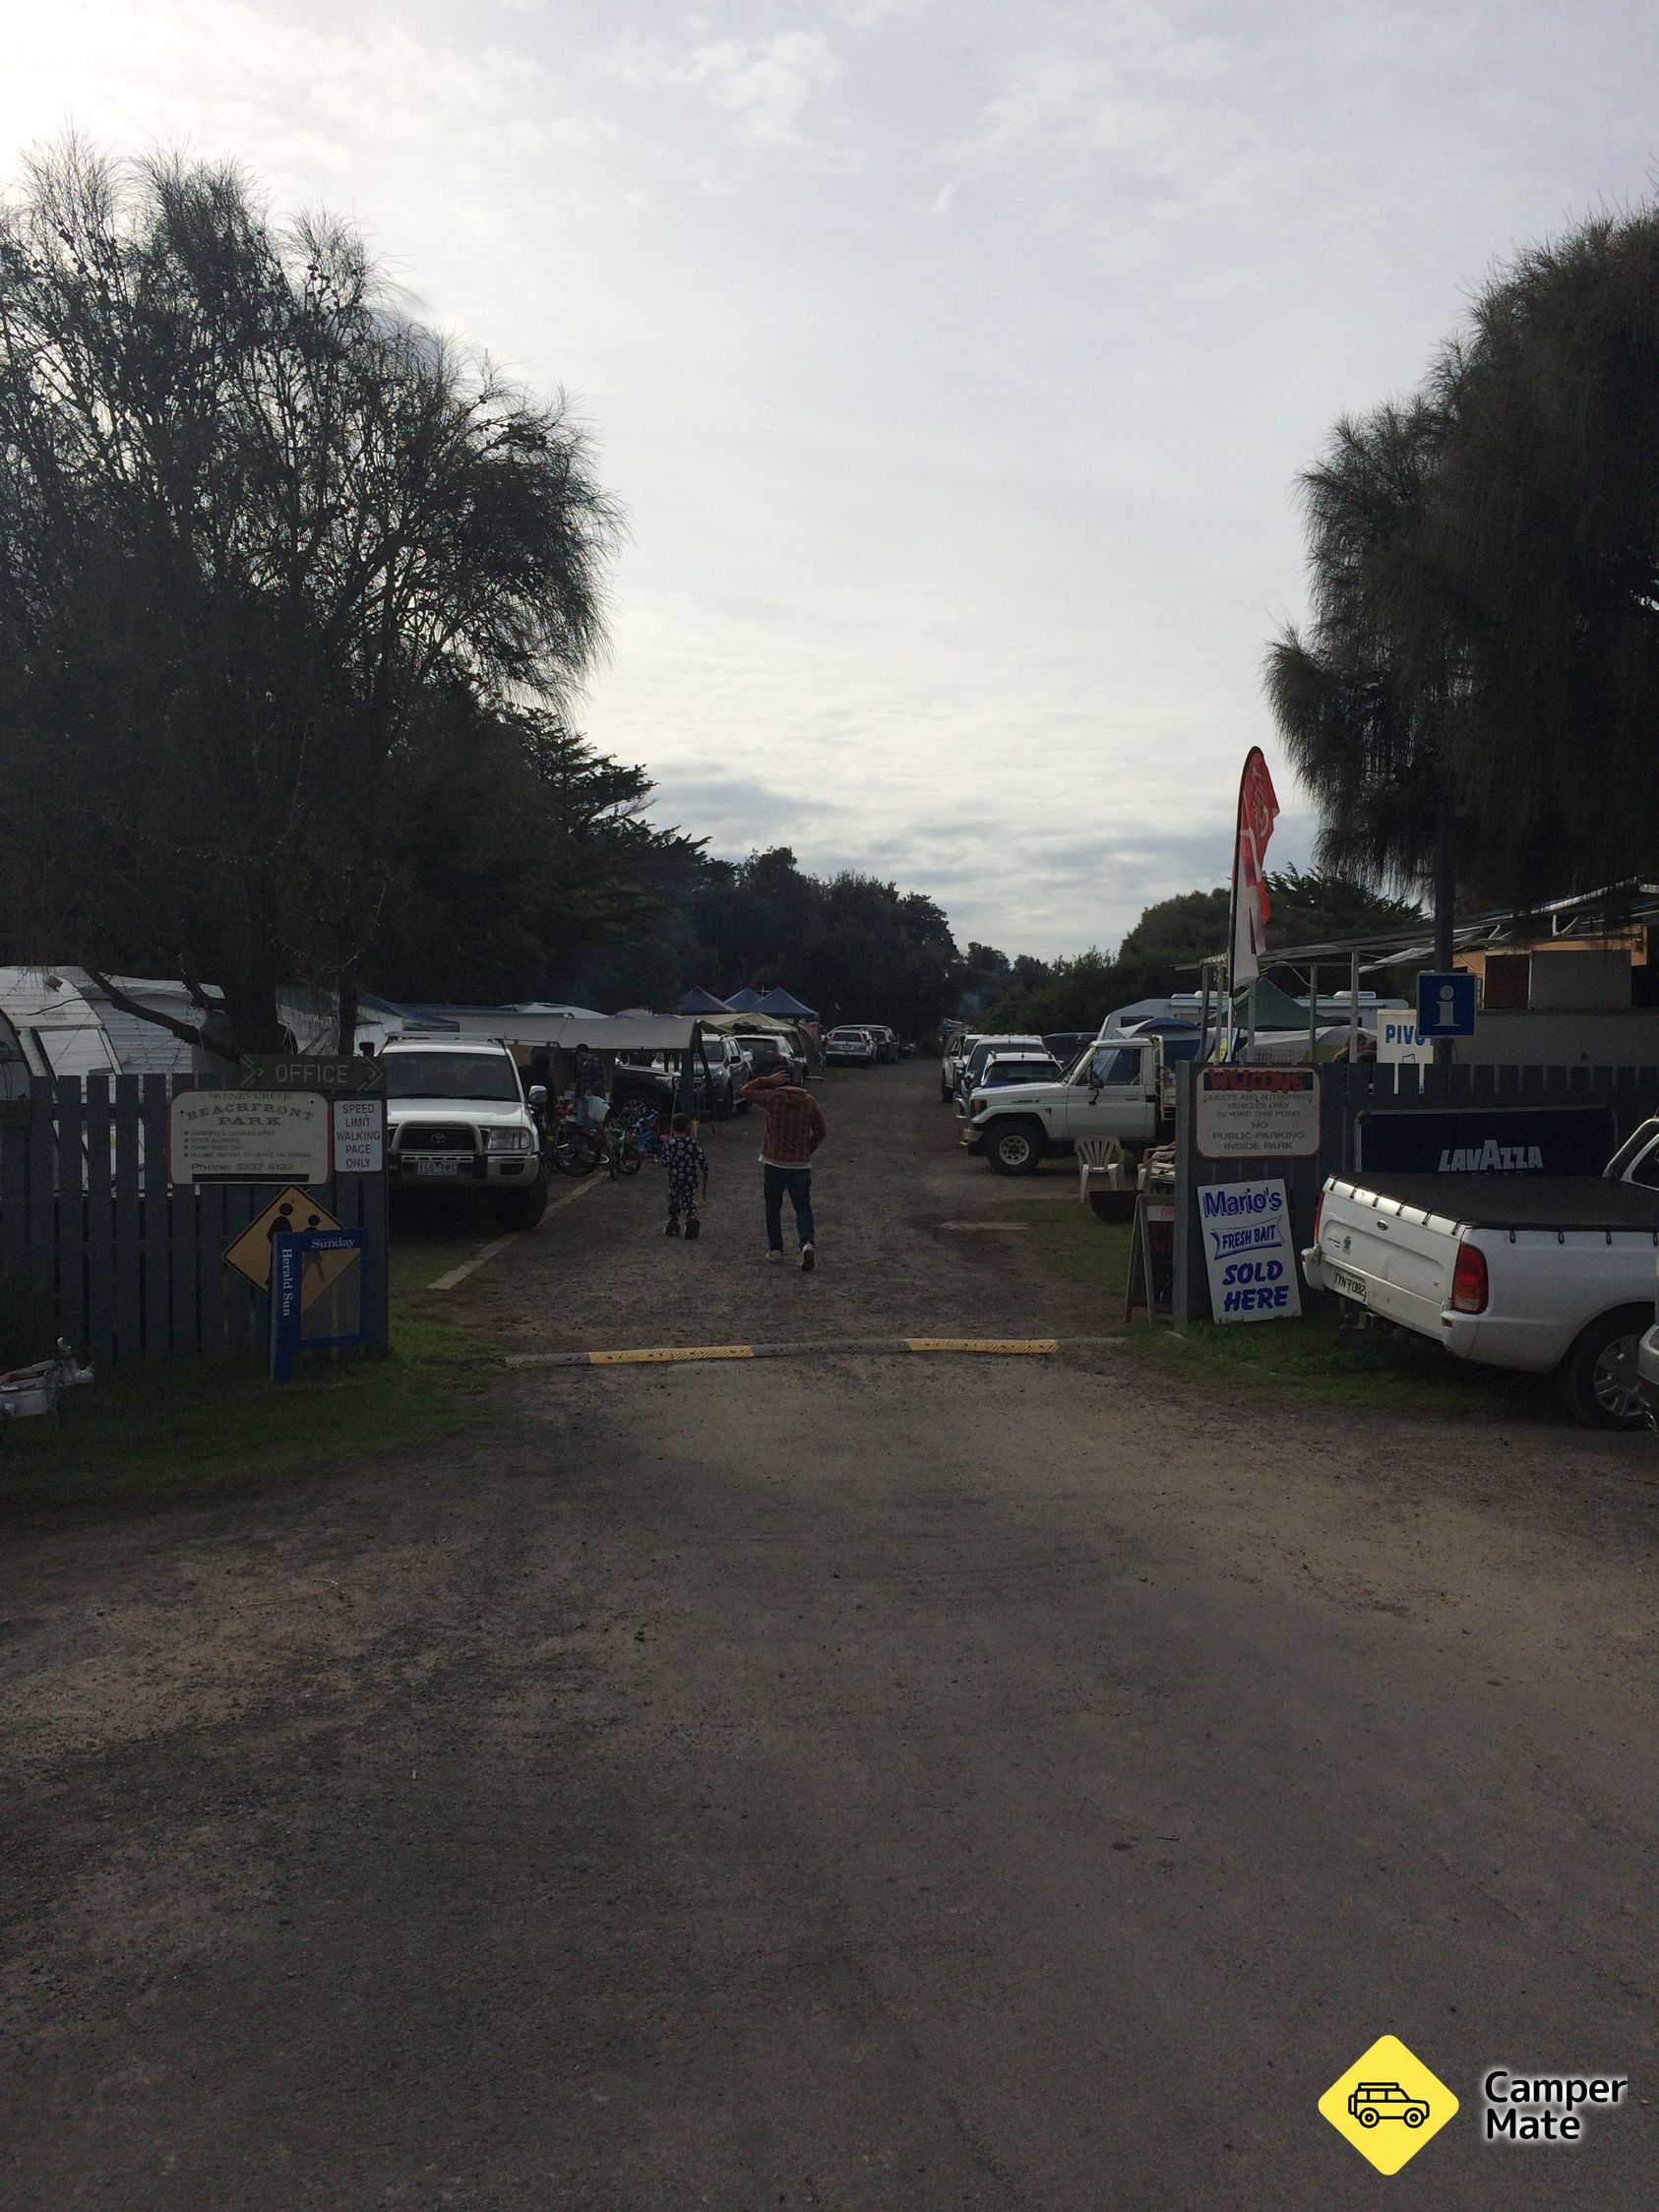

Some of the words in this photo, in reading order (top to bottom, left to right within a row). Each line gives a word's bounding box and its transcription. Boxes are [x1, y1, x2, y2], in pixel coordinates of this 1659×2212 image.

[1384, 1024, 1434, 1047] PIV
[275, 1064, 349, 1083] OFFICE
[186, 1102, 315, 1121] BEACHFRONT
[342, 1103, 375, 1114] SPEED
[216, 1117, 282, 1126] PARK
[344, 1117, 371, 1128] LIMIT
[337, 1131, 382, 1141] WALKING
[1212, 1132, 1253, 1140] PUBLIC
[1256, 1131, 1305, 1139] PARKING
[344, 1144, 371, 1154] PACE
[1224, 1141, 1260, 1150] INSIDE
[1263, 1141, 1293, 1150] PARK
[1439, 1137, 1544, 1173] LAVAZZA
[345, 1157, 371, 1169] ONLY
[1202, 1187, 1283, 1218] Mario's
[311, 1237, 356, 1250] Sunday
[1222, 1229, 1253, 1250] FRESH
[1254, 1224, 1276, 1243] BAIT
[281, 1248, 293, 1290] Herald
[1222, 1260, 1284, 1286] SOLD
[281, 1291, 293, 1317] Sun
[1223, 1285, 1290, 1313] HERE
